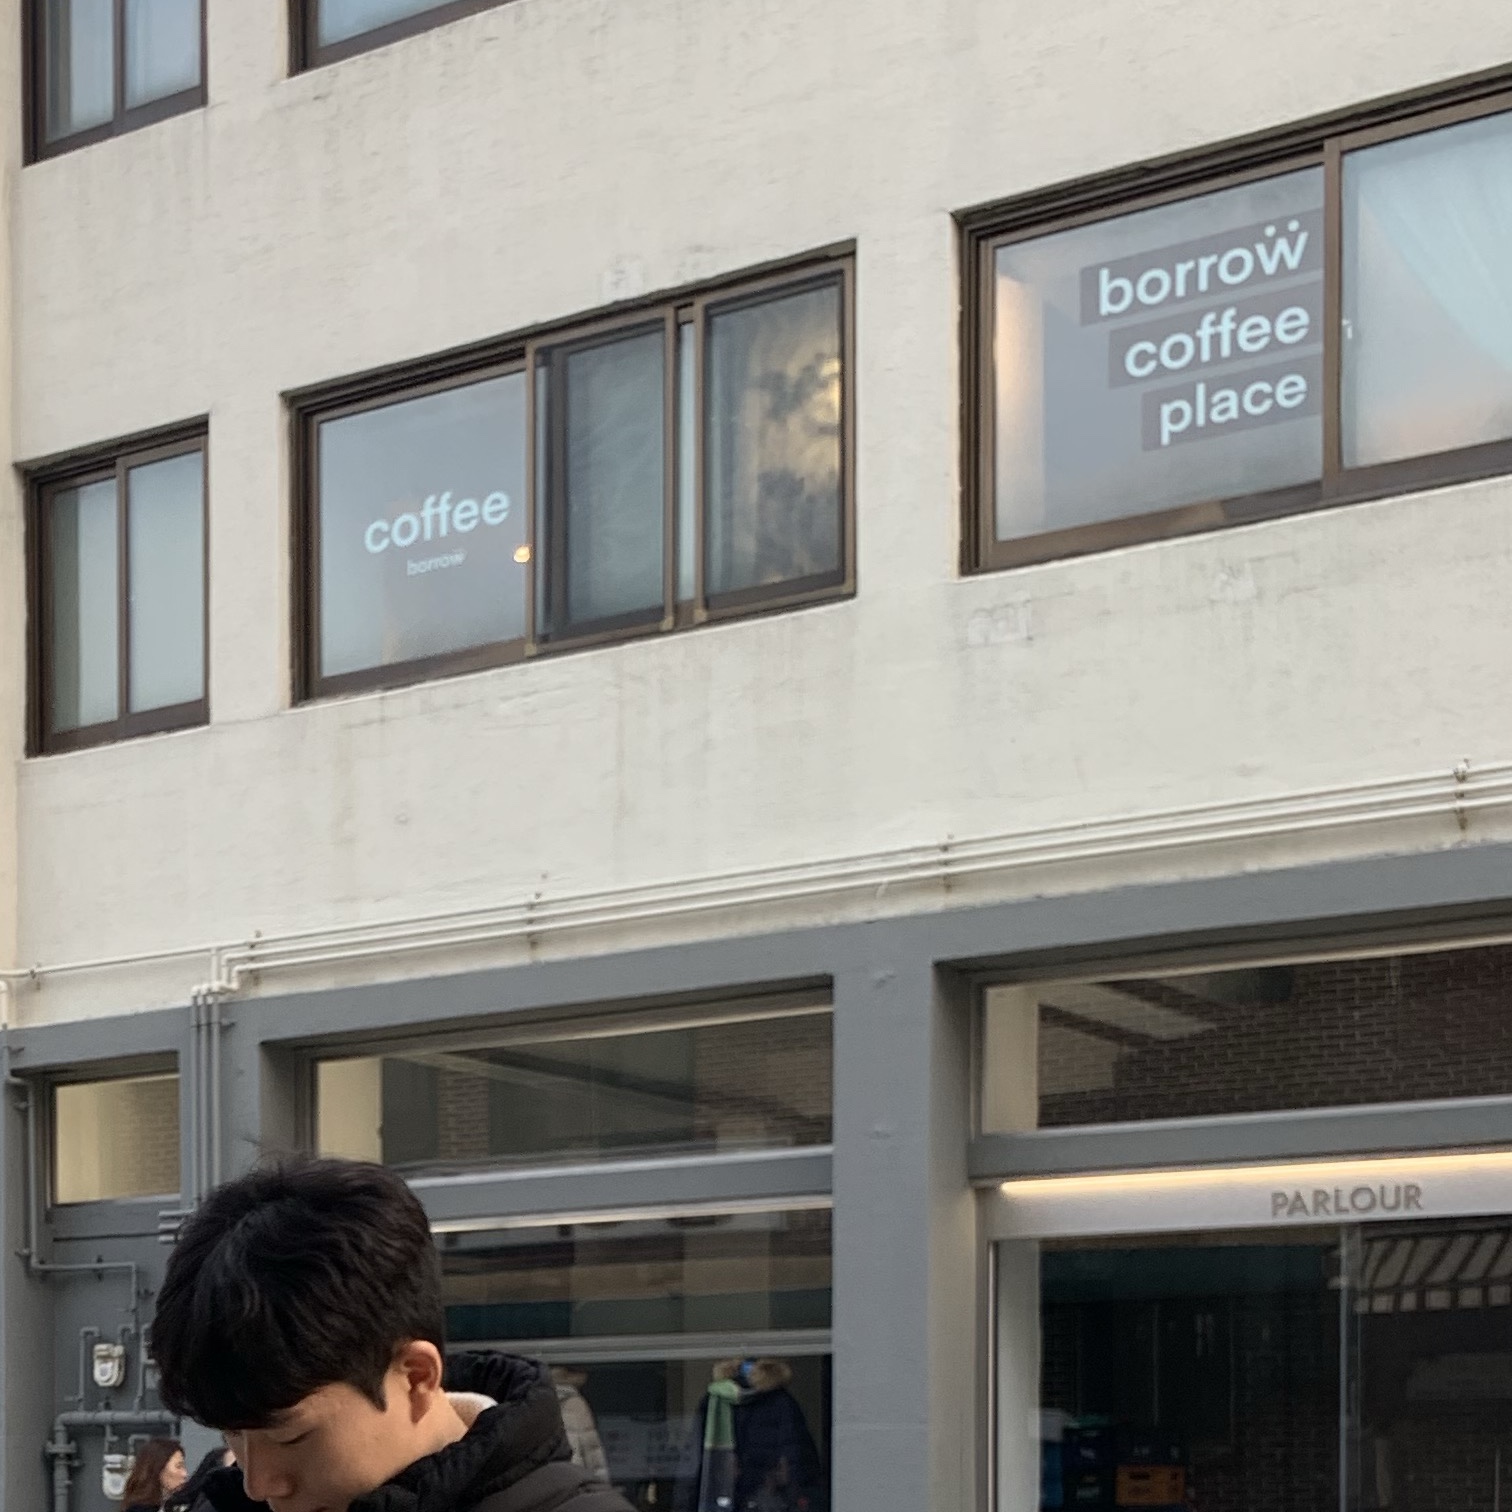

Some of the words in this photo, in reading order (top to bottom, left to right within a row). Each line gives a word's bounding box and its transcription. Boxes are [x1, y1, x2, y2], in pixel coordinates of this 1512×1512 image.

[1124, 306, 1311, 378] coffee
[1160, 373, 1308, 446] place
[364, 490, 511, 554] coffee
[1270, 1184, 1423, 1219] PARLOUR
